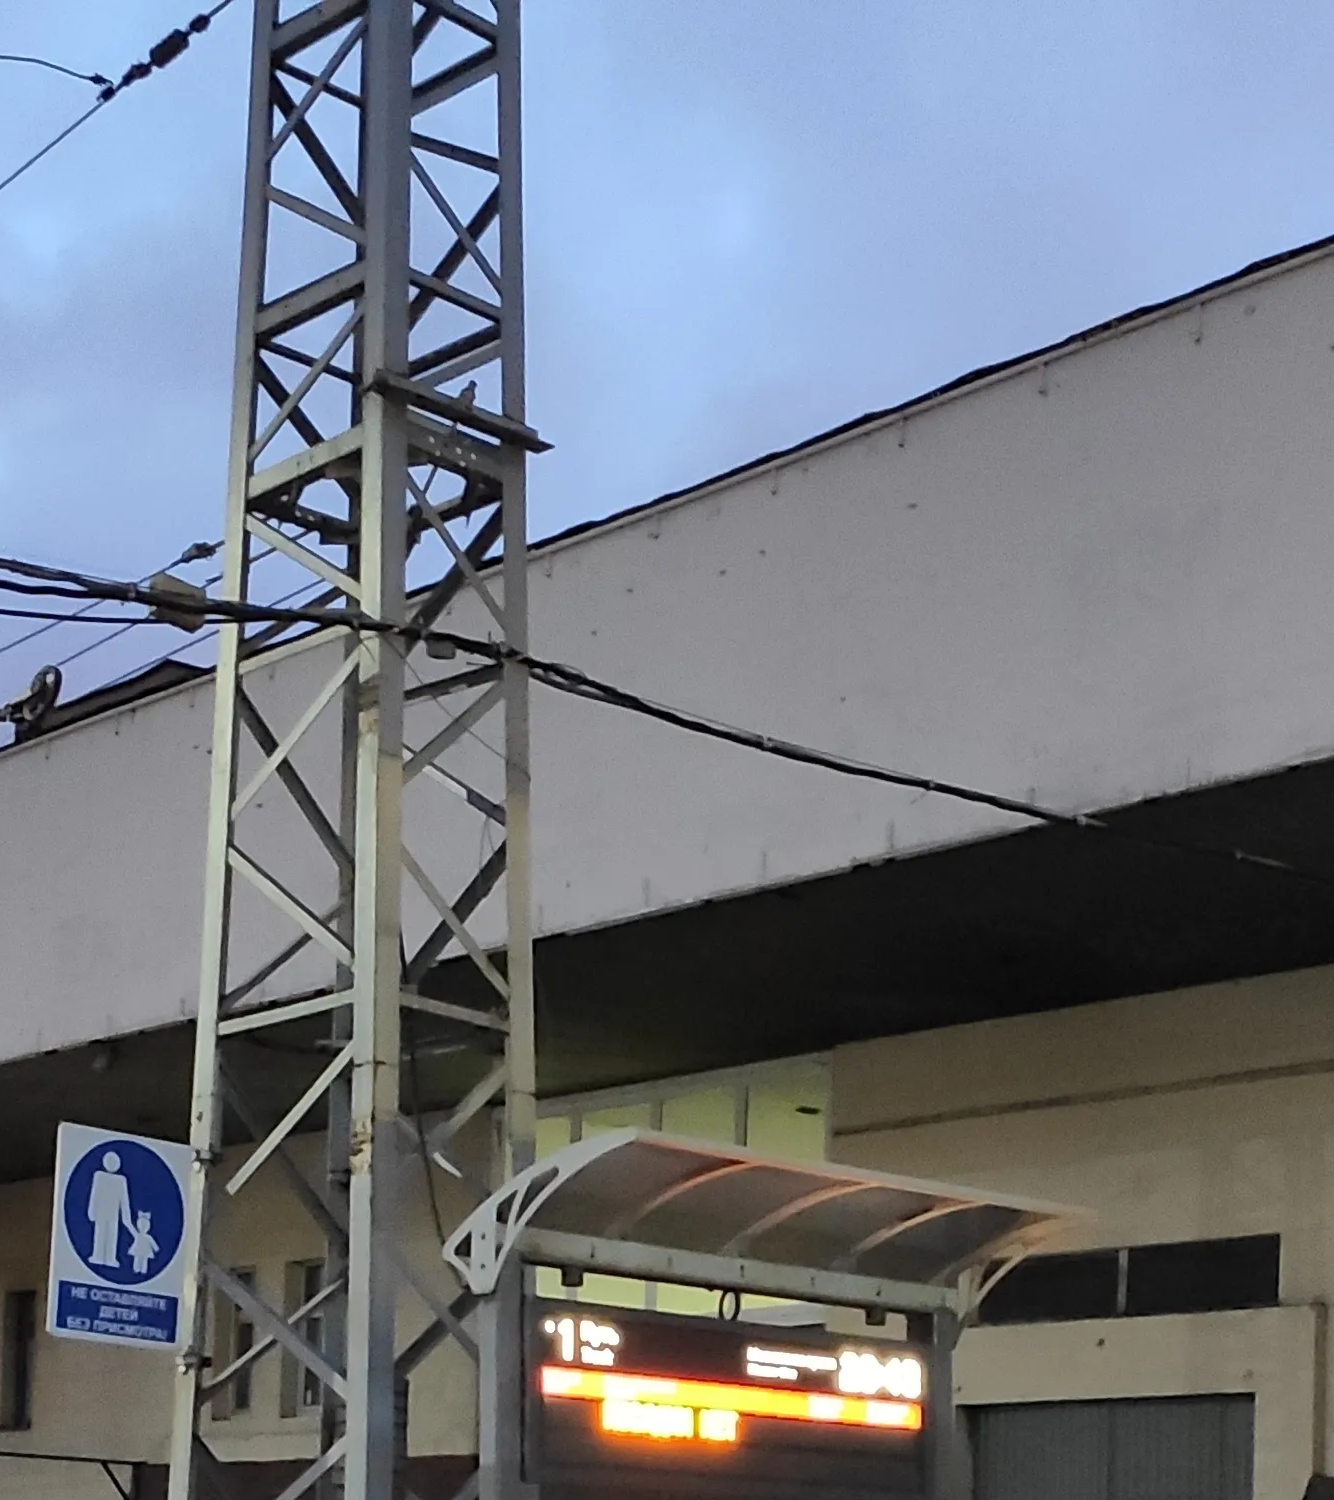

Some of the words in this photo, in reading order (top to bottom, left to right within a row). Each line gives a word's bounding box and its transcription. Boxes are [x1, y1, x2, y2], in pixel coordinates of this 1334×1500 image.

[71, 1286, 88, 1299] НЕ
[90, 1288, 167, 1311] ОСТАВЛЯЙТЕ
[99, 1305, 139, 1321] ДЕТЕЙ
[67, 1316, 91, 1331] БЕЗ
